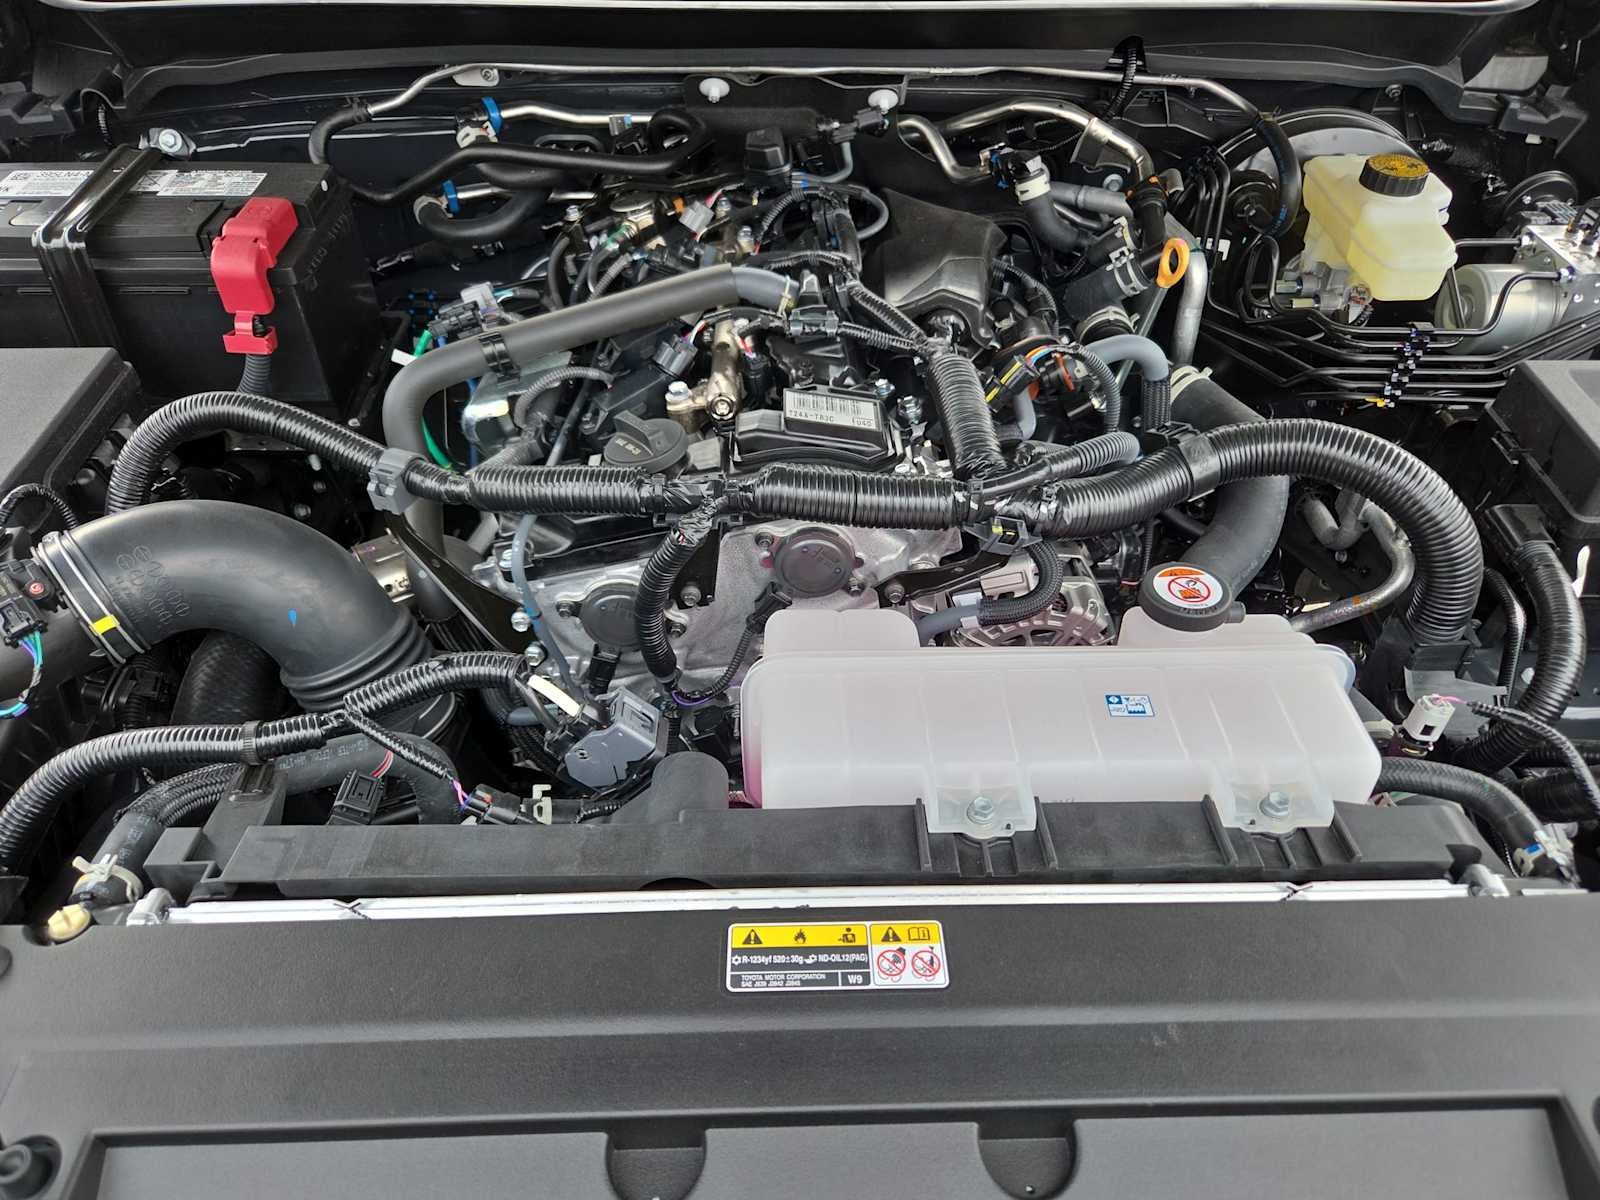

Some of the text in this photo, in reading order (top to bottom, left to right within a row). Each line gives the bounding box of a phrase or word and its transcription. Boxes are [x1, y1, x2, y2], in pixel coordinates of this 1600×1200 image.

[742, 954, 772, 965] R-1234yf
[818, 952, 868, 963] ND-OIL12(PAG)
[741, 973, 826, 982] TOYOTA MOTOR CORPORATION
[848, 974, 863, 984] W9
